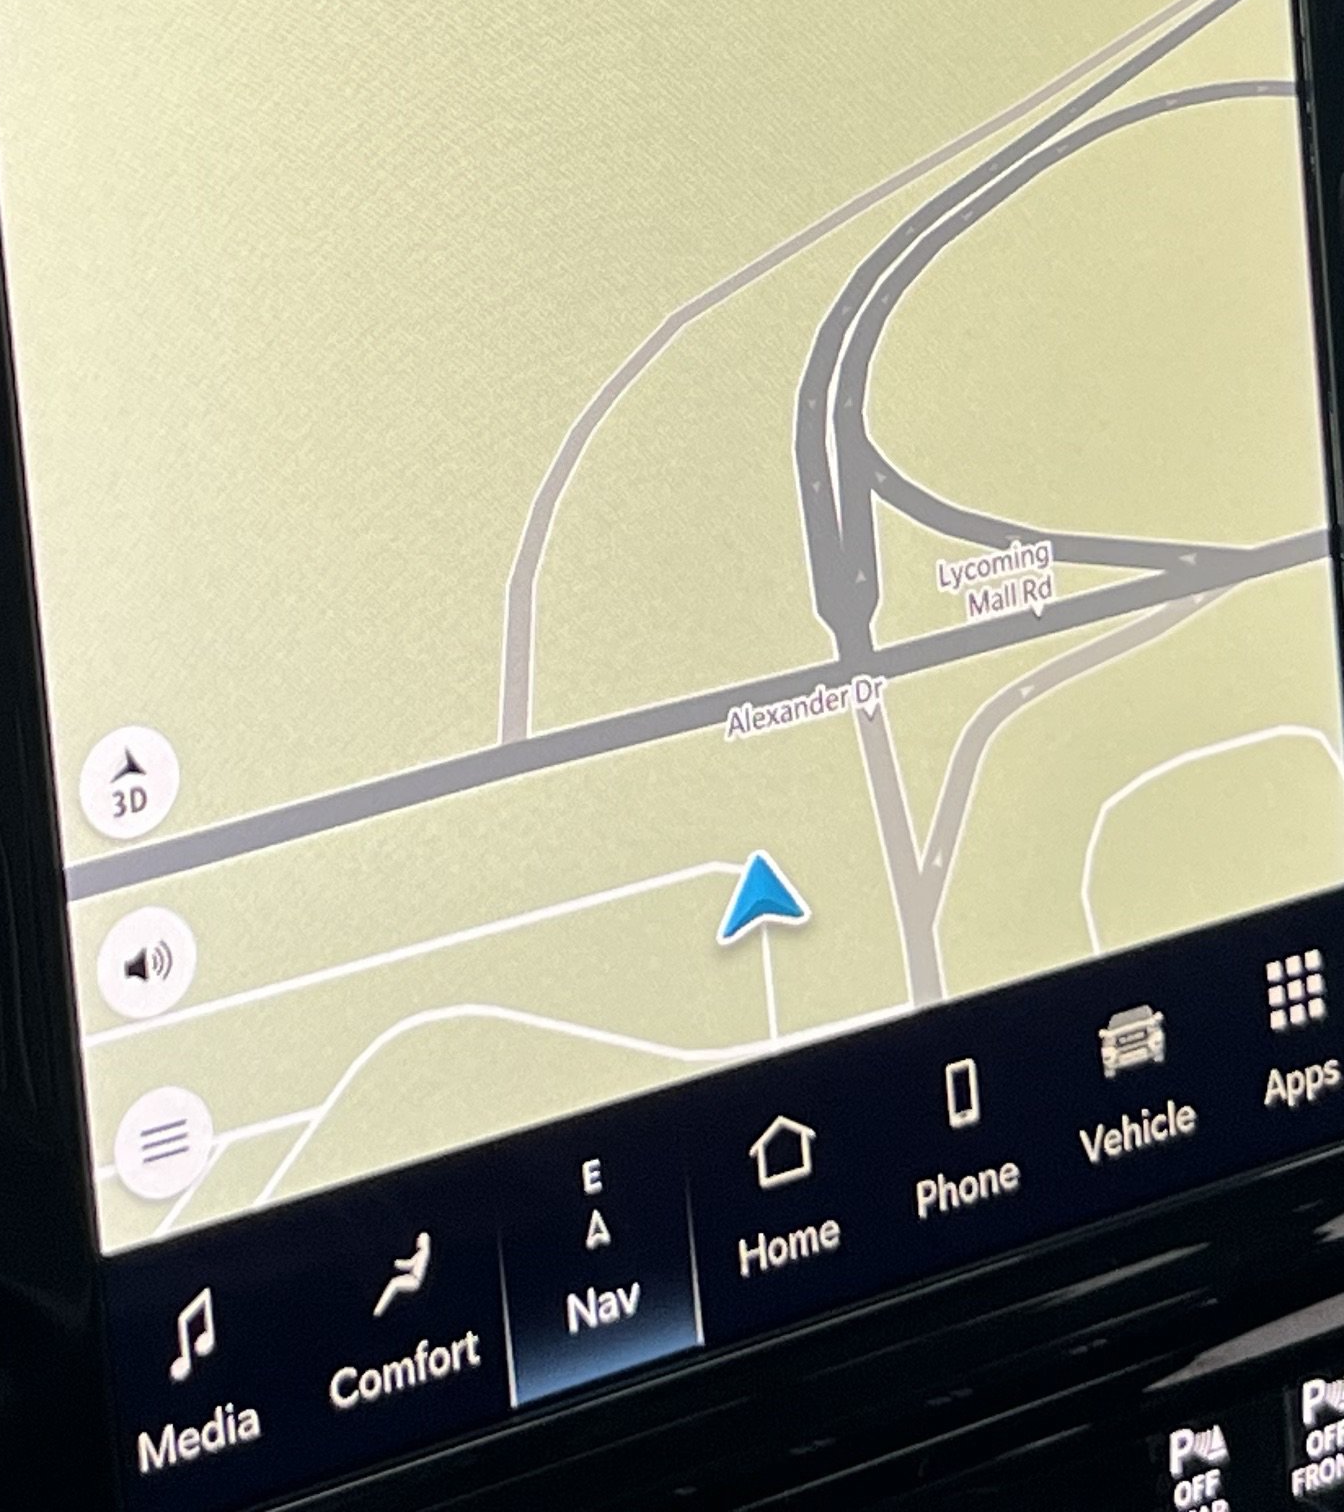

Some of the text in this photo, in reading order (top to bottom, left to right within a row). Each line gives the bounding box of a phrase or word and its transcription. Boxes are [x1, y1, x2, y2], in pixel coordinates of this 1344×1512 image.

[938, 541, 1050, 589] Lycoming
[968, 575, 1053, 618] Mall Rd
[727, 678, 883, 737] Alexander Dr
[111, 785, 148, 819] 3D
[1263, 1056, 1342, 1110] Apps
[1079, 1098, 1198, 1166] Vehicle
[581, 1157, 604, 1196] E
[915, 1157, 1021, 1221] Phone
[738, 1217, 841, 1279] Home
[565, 1281, 641, 1336] Nav
[328, 1328, 482, 1411] Comfort
[135, 1402, 262, 1474] Media
[1174, 1468, 1222, 1511] OFF
